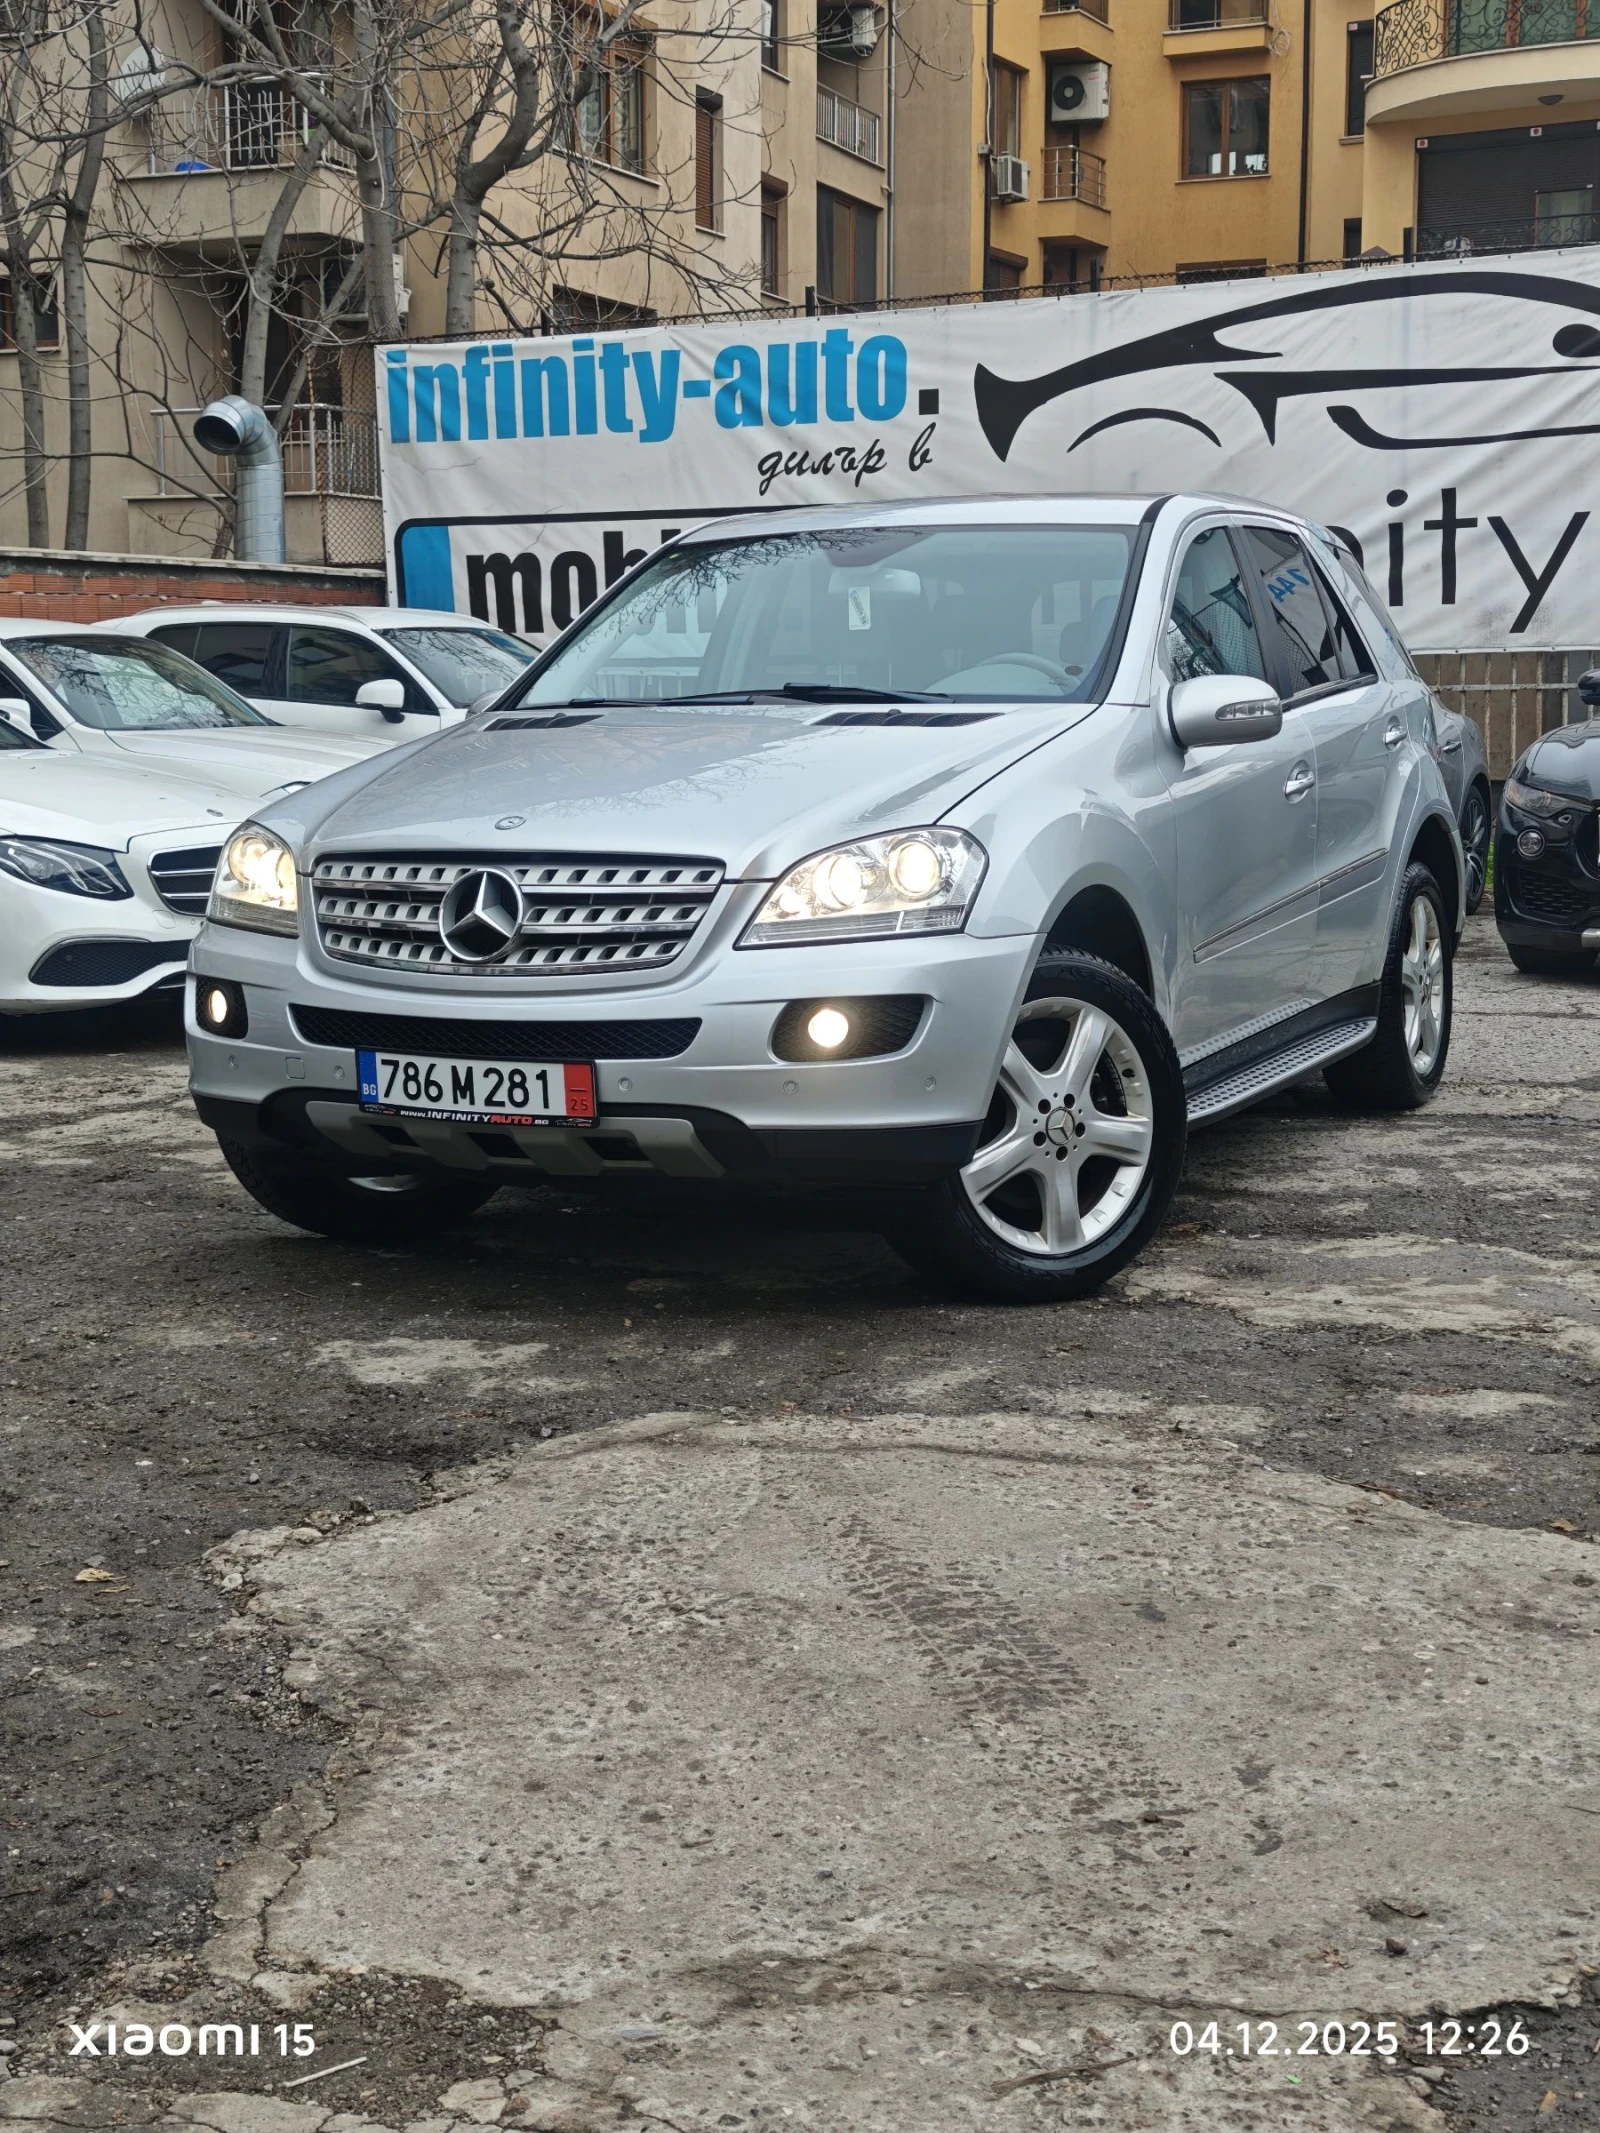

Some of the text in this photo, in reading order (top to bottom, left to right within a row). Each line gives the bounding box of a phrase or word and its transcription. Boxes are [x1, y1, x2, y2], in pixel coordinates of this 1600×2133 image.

[757, 438, 888, 497] дилър
[362, 1083, 377, 1096] BG
[570, 1097, 588, 1111] 25
